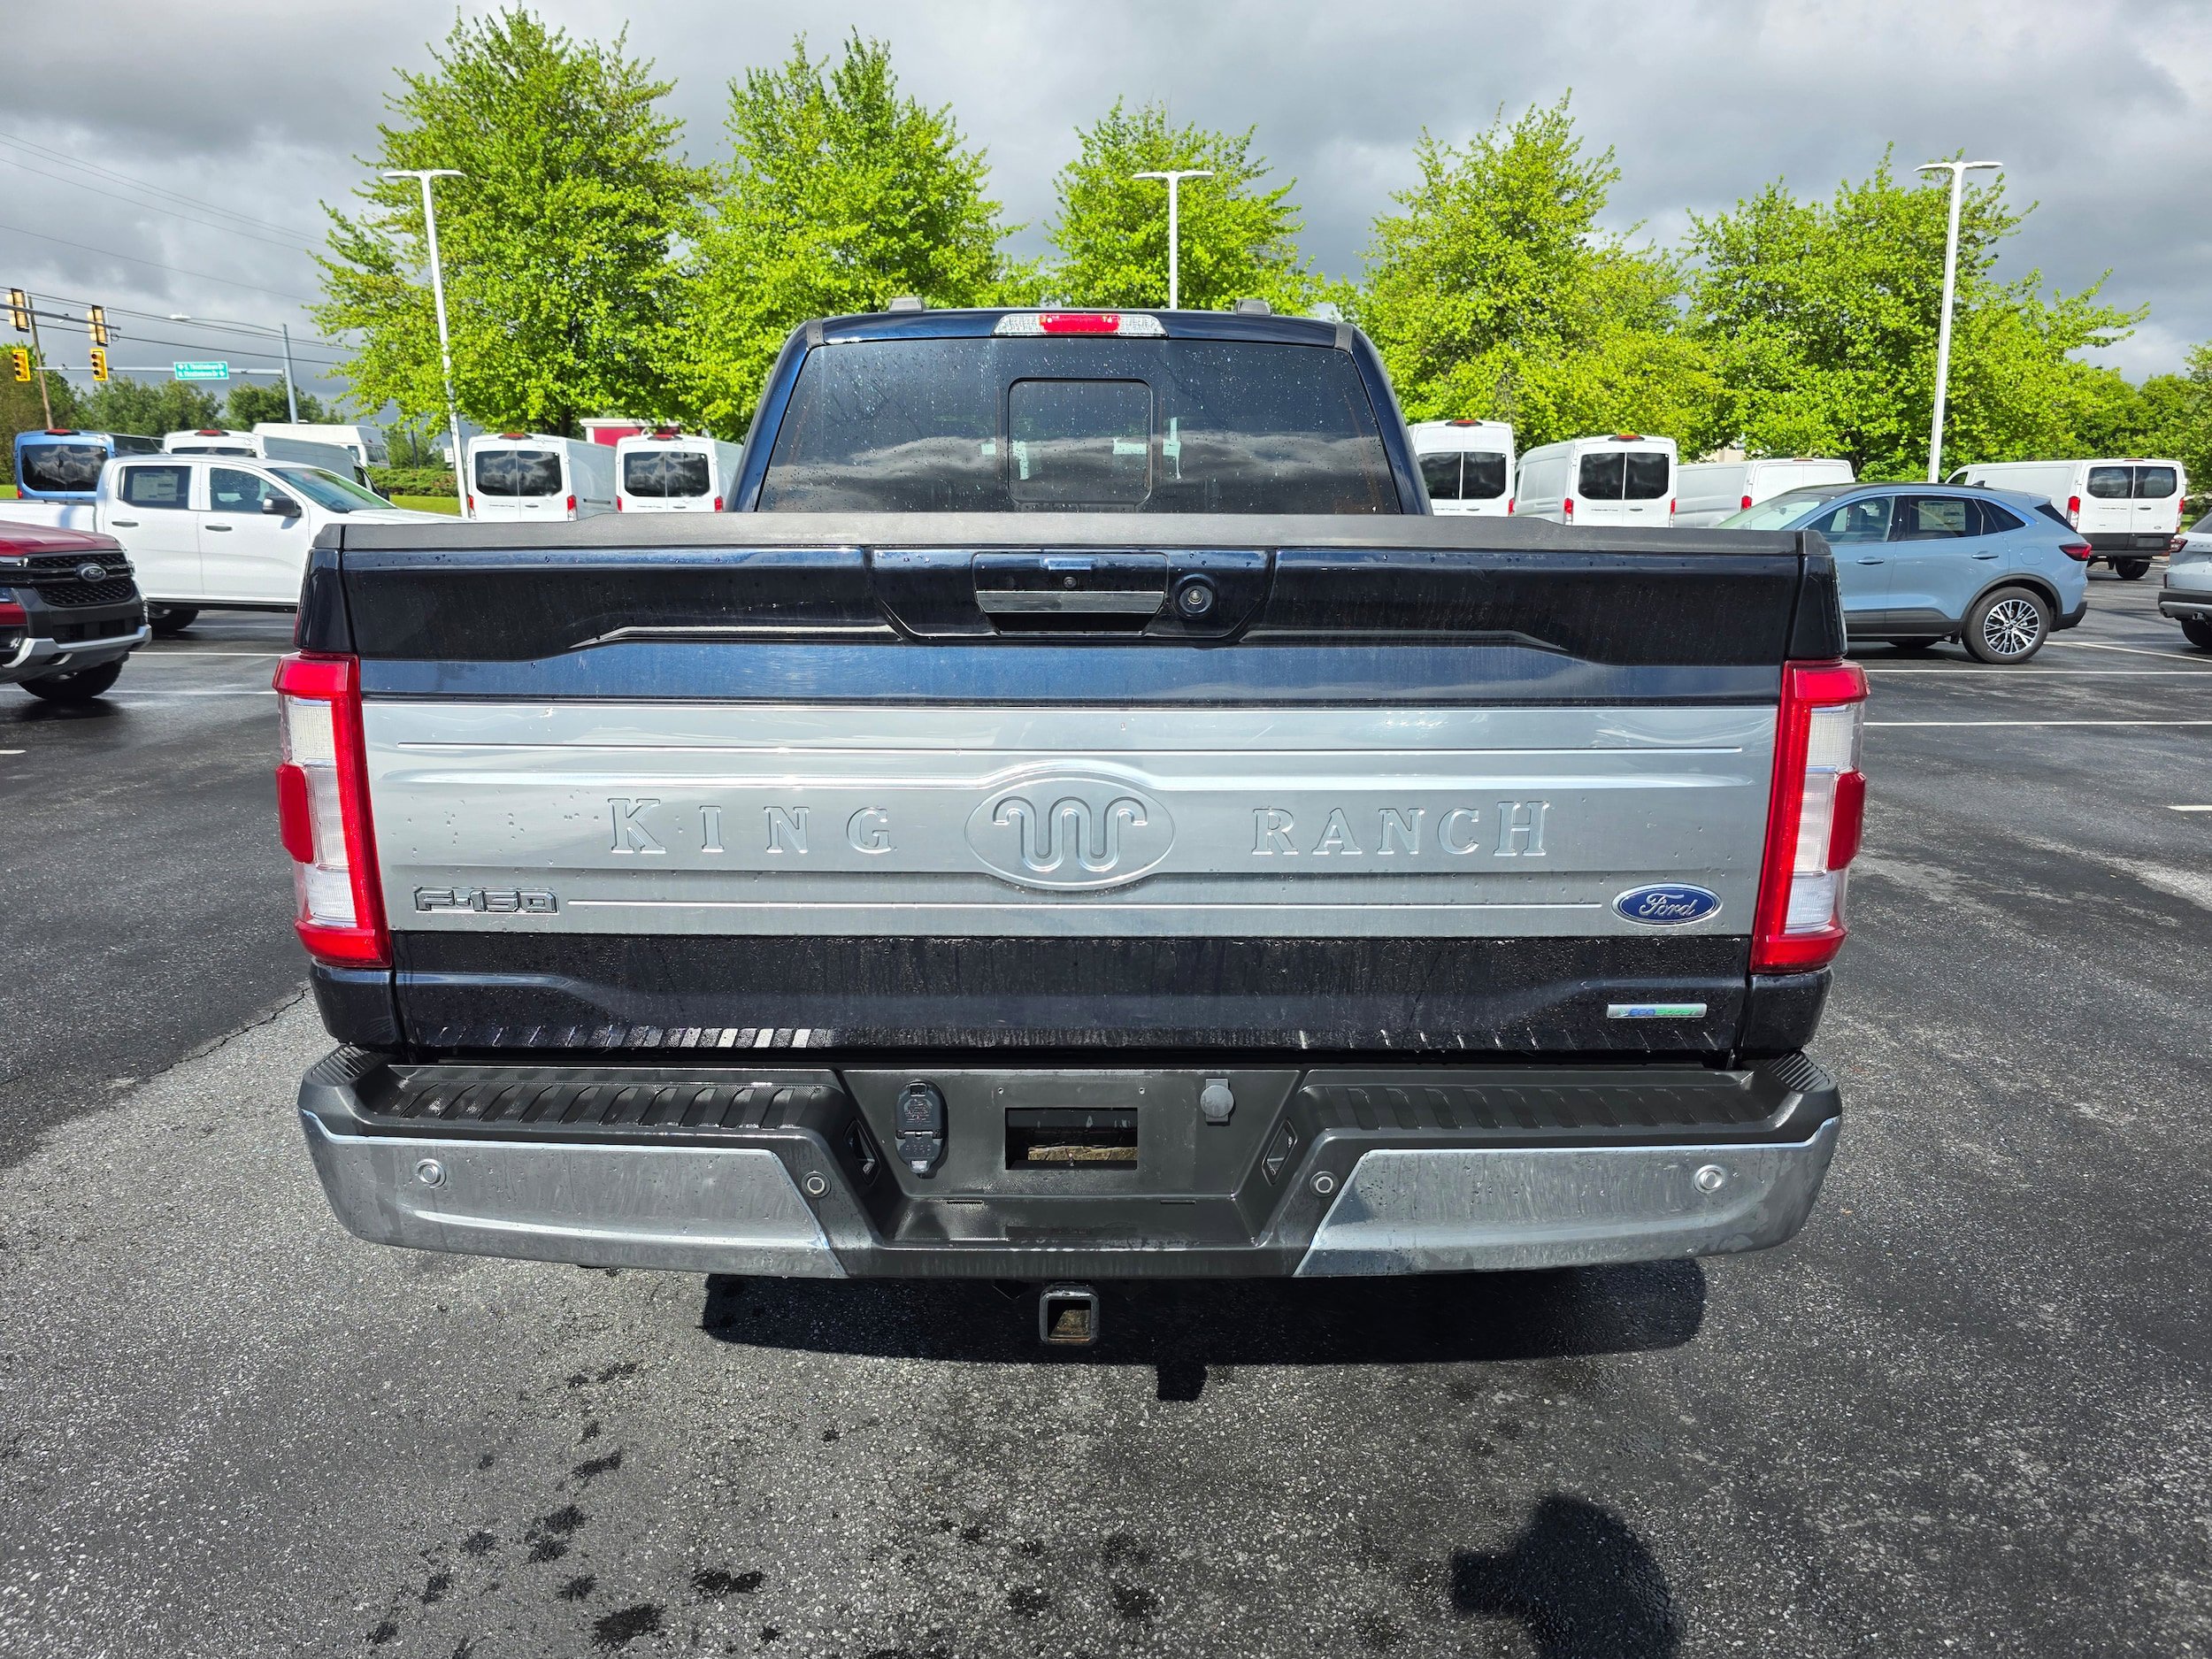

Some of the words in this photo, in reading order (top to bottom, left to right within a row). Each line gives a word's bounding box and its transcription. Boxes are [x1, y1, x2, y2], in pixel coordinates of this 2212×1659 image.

[607, 797, 893, 854] KING
[1251, 800, 1549, 856] RANCH
[415, 887, 560, 915] F-150
[1638, 893, 1699, 917] Ford
